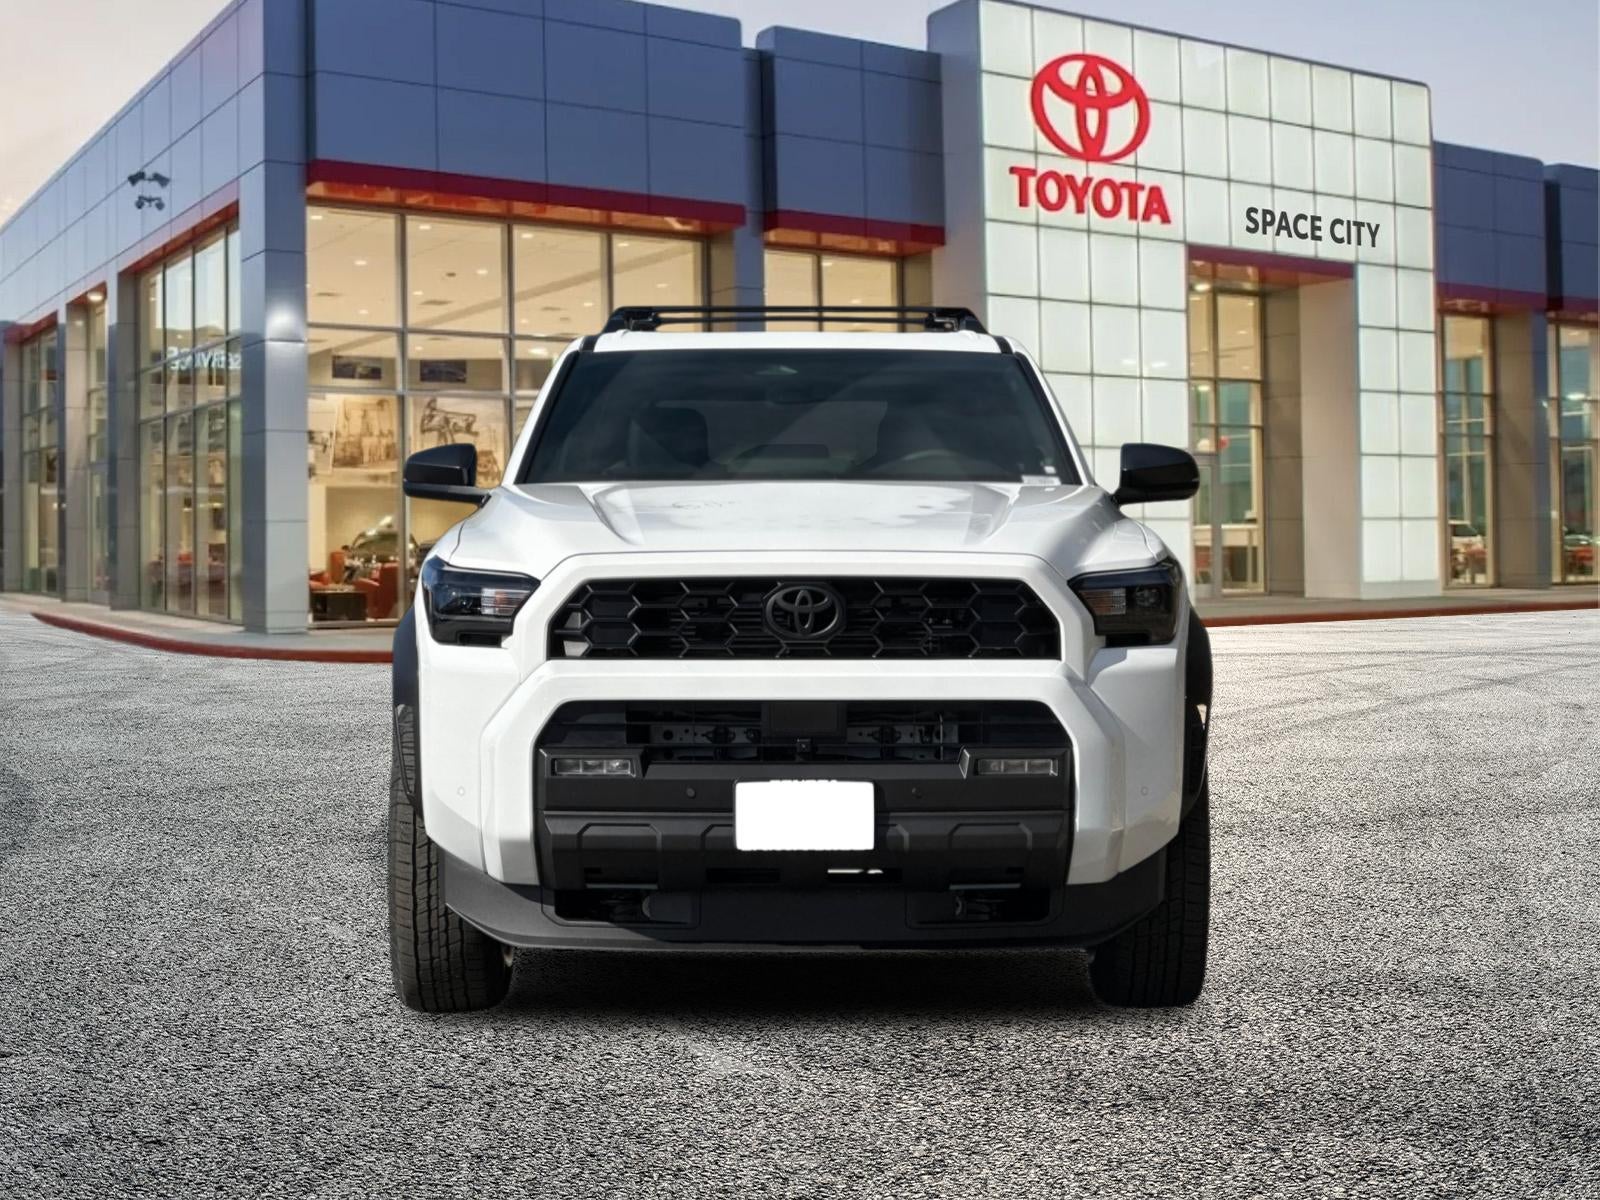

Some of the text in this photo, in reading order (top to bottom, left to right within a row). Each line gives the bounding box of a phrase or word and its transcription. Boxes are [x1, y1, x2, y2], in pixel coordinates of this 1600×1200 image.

[1009, 166, 1171, 224] TOYOTA
[1245, 206, 1381, 248] SPACE CITY
